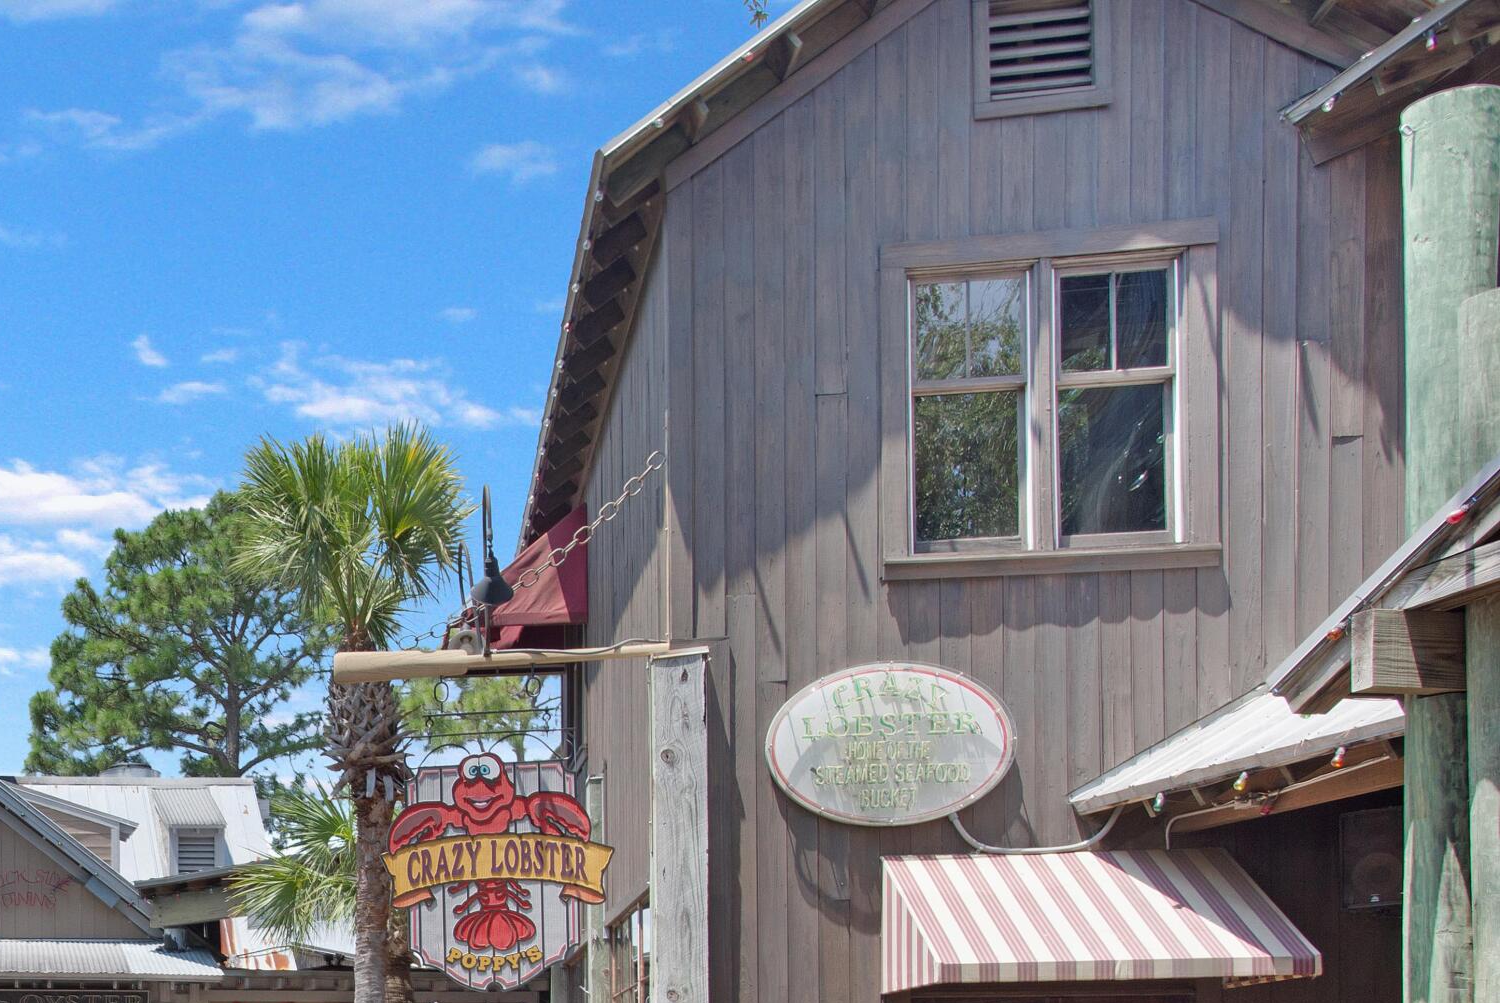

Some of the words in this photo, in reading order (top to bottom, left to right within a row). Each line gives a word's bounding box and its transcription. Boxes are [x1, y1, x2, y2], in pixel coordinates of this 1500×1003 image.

[832, 671, 949, 710] CRAZY
[801, 711, 981, 740] LOBSTER
[846, 740, 883, 761] HOME
[886, 740, 906, 760] OF
[906, 740, 933, 760] THE
[814, 765, 889, 785] STEAMED
[894, 763, 973, 784] SEAFOOD
[858, 787, 917, 810] BUCKET
[407, 840, 482, 886] CRAZY
[490, 839, 588, 881] LOBSTER
[446, 945, 543, 972] POPPY'S
